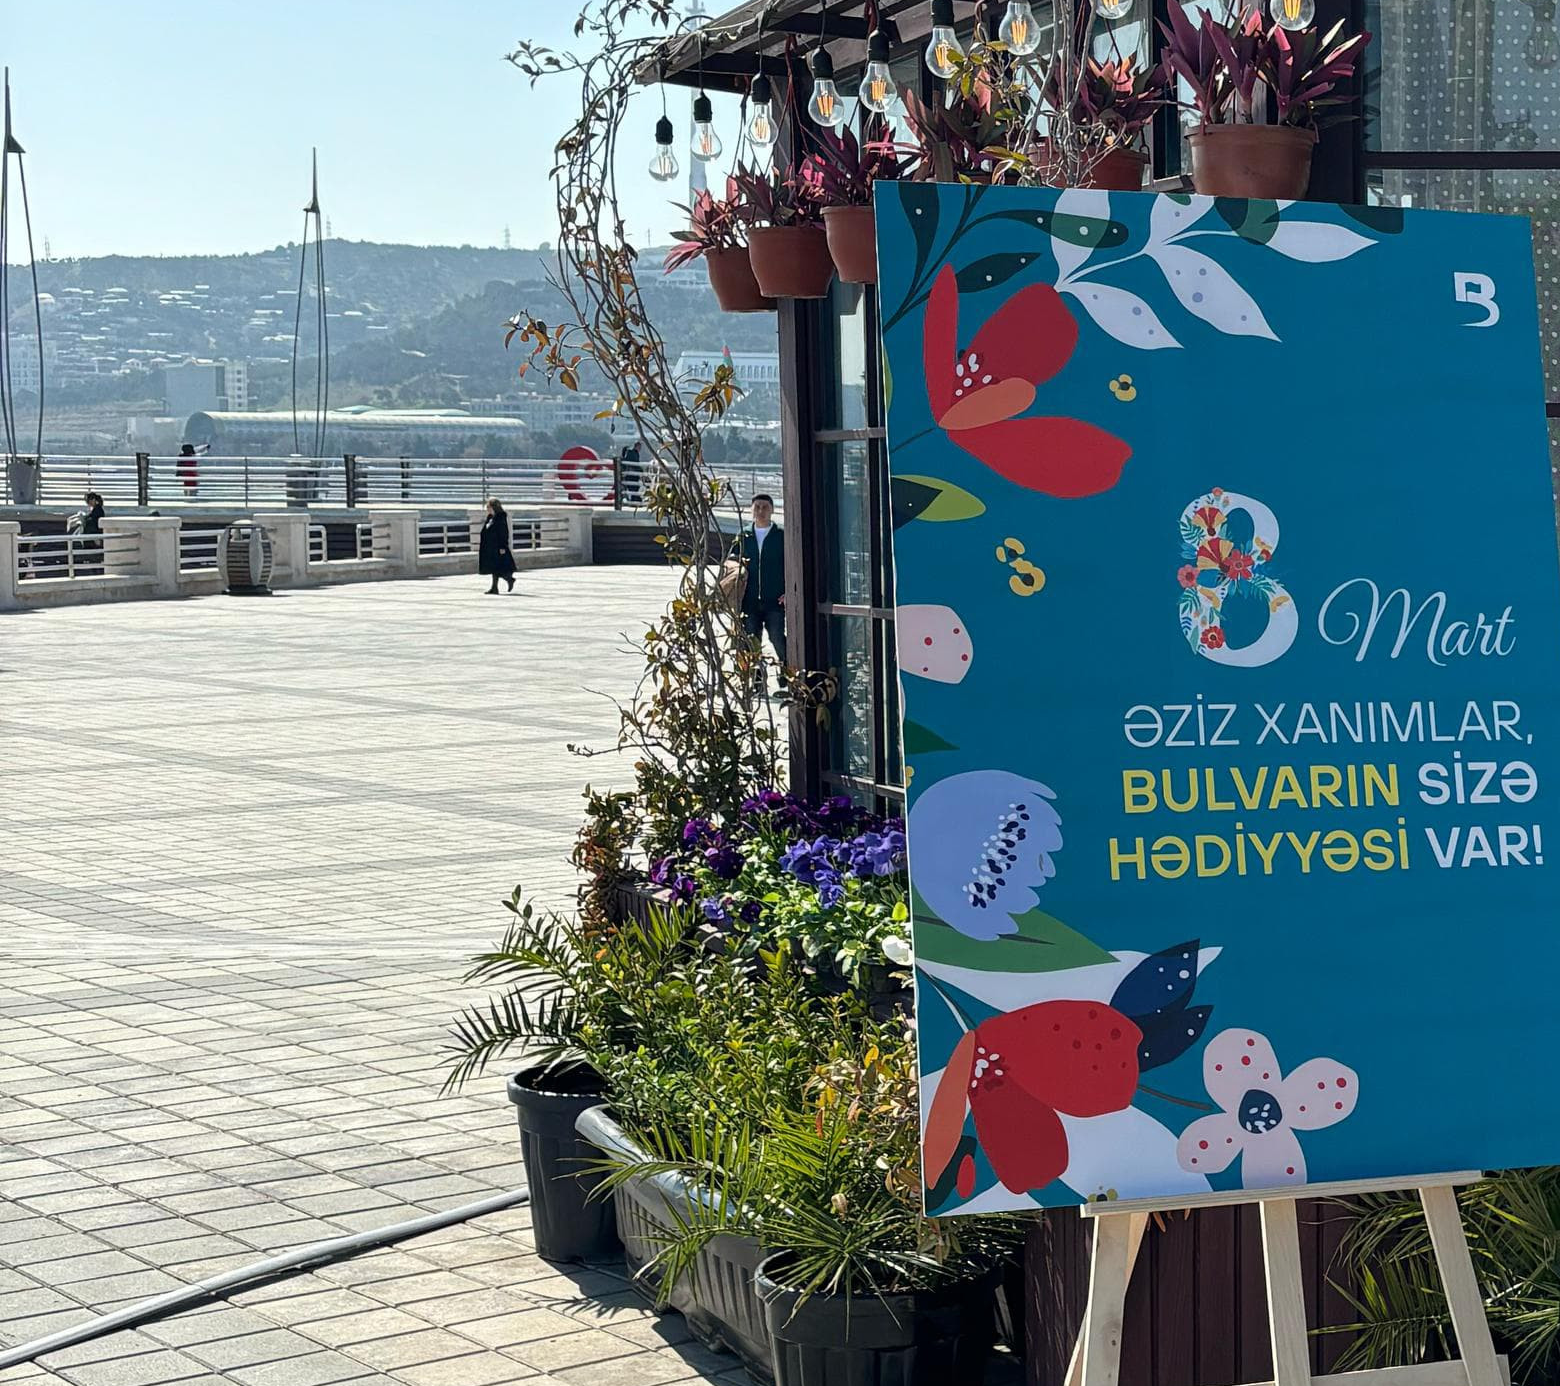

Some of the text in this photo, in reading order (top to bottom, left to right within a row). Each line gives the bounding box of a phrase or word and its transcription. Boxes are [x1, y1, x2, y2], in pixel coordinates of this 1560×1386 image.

[1177, 487, 1516, 668] 8 Mart
[1123, 693, 1534, 748] ƏZİZ XANIMLAR,
[1122, 750, 1539, 814] BULVARIN SİZƏ
[1108, 816, 1545, 881] HƏDİYYƏSİ VAR!
